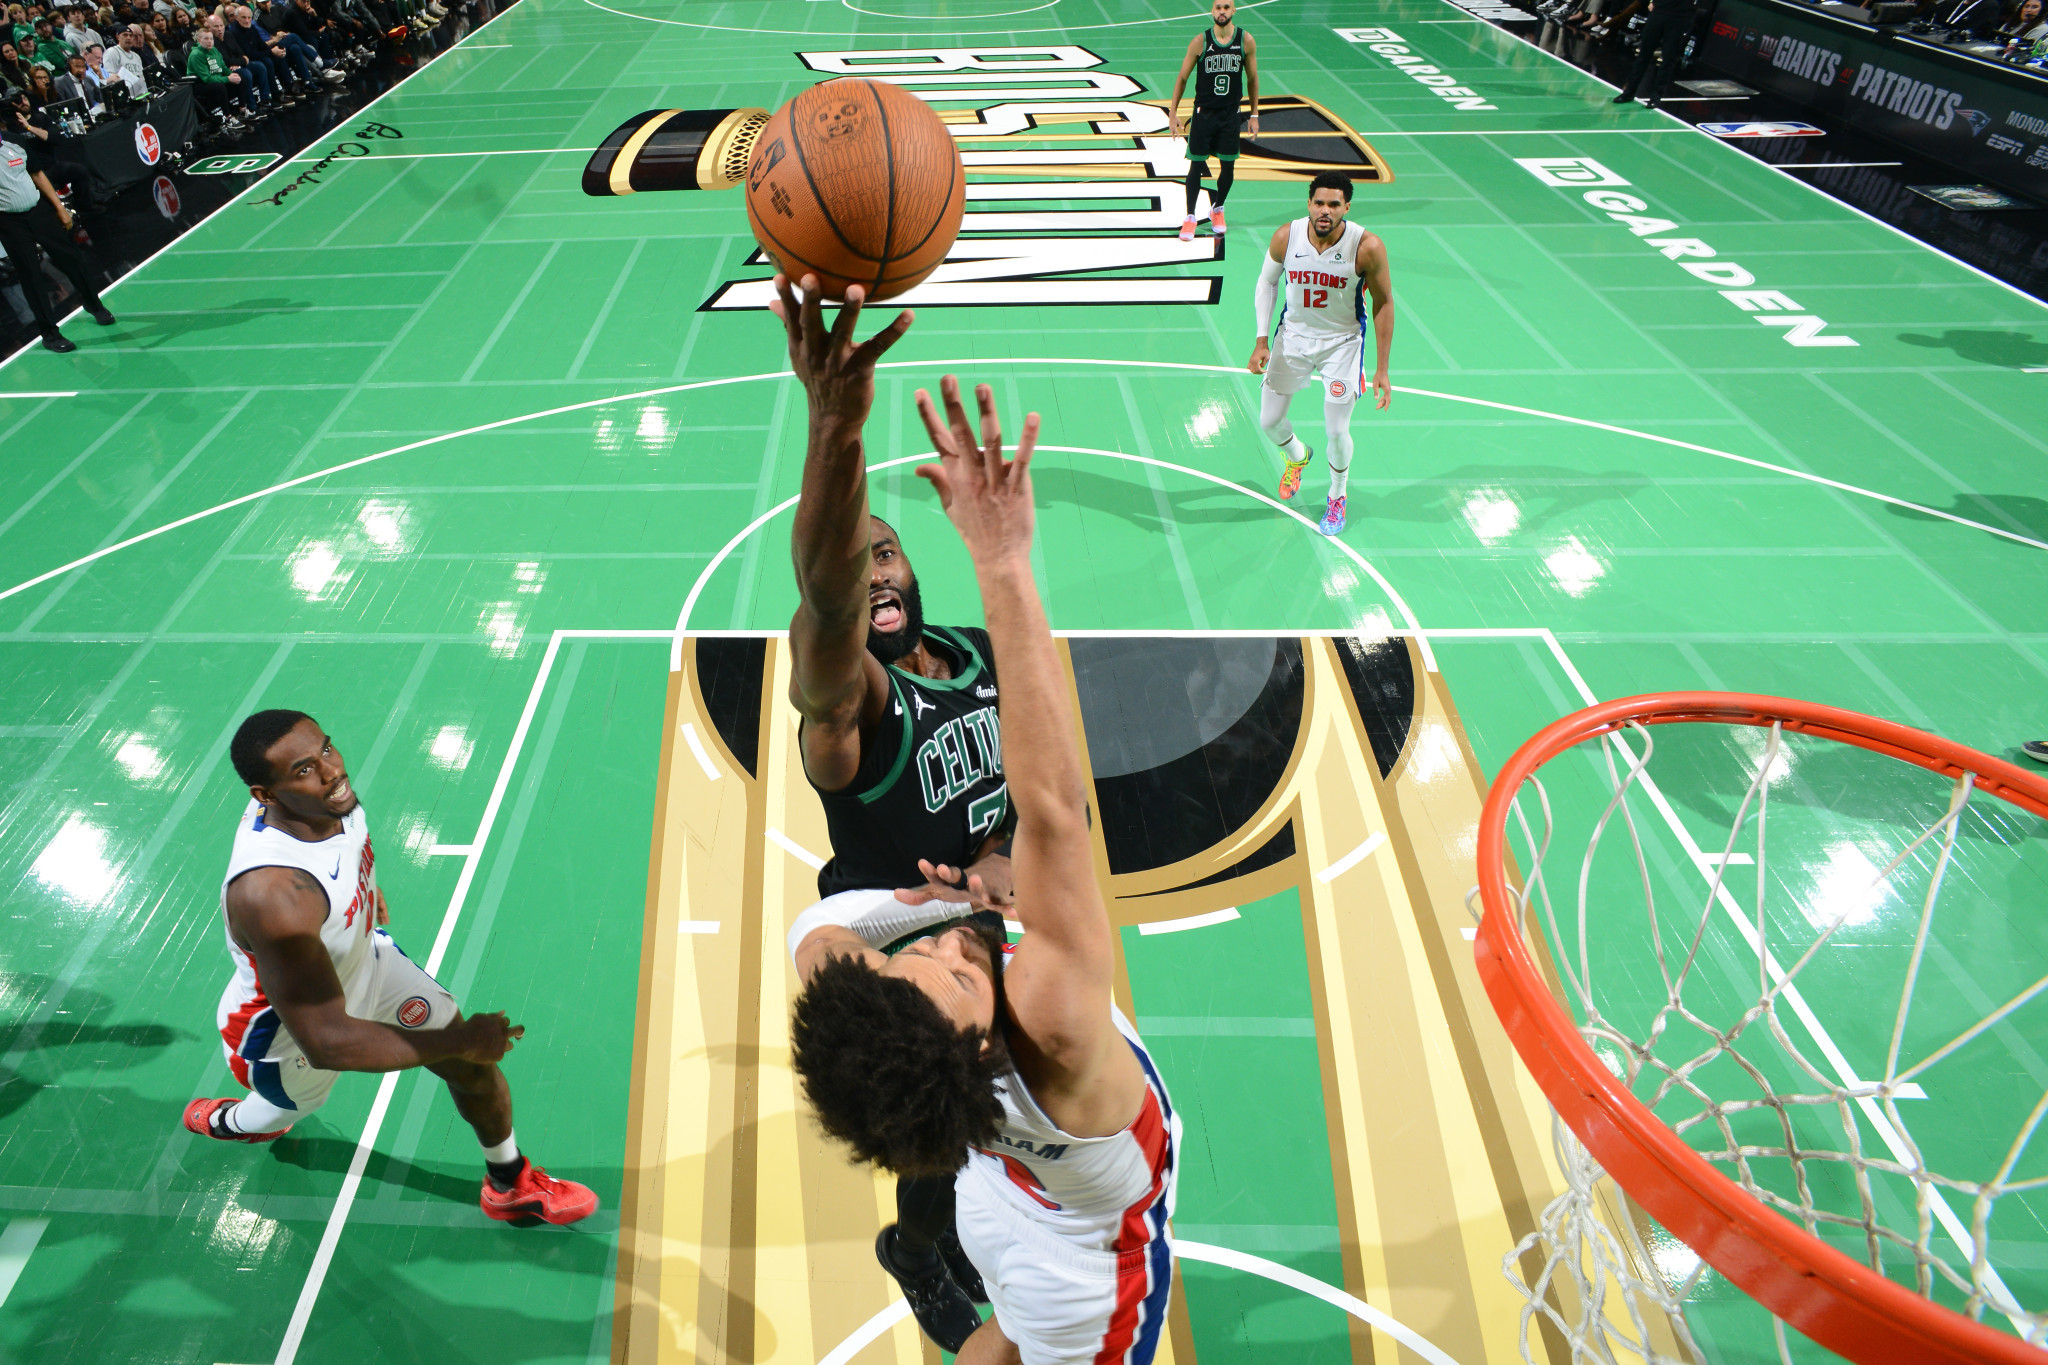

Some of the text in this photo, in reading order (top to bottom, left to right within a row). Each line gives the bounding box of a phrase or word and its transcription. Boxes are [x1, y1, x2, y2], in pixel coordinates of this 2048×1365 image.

[1204, 54, 1242, 73] CELTICS
[1214, 74, 1230, 95] 9
[1369, 43, 1499, 110] GARDEN
[1713, 21, 1739, 40] ESPN
[1773, 35, 1842, 87] GIANTS
[1840, 67, 1854, 80] AT
[1851, 62, 1962, 131] PATRIOTS
[1986, 133, 2024, 156] ESPN
[695, 45, 1225, 311] BOSTON
[1288, 270, 1349, 289] PISTONS
[1583, 190, 1861, 347] GARDEN
[1303, 288, 1328, 309] 12
